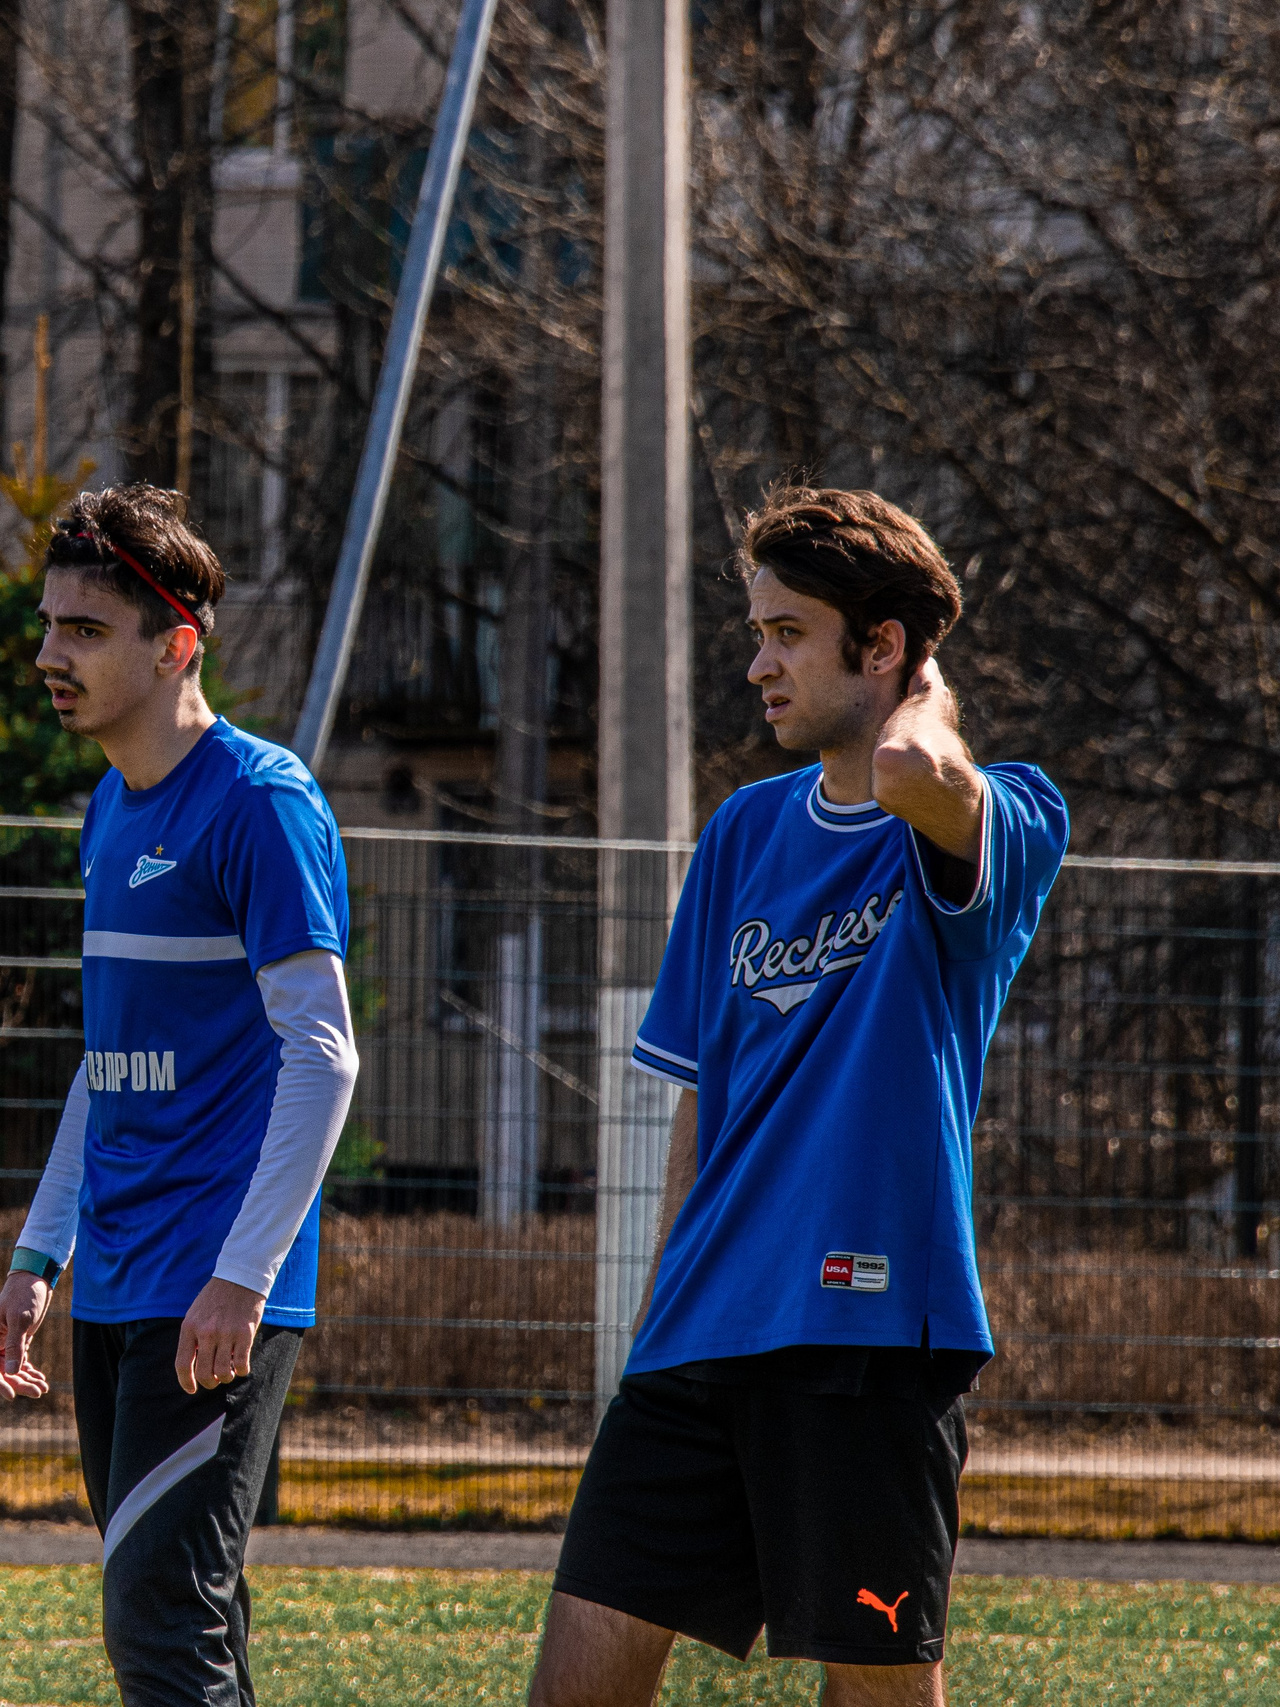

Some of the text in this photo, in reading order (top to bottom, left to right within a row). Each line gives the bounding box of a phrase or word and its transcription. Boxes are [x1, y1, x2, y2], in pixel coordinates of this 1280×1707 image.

[86, 1050, 176, 1092] АЗПРОМ
[826, 1265, 849, 1274] USA
[856, 1261, 885, 1270] 1992
